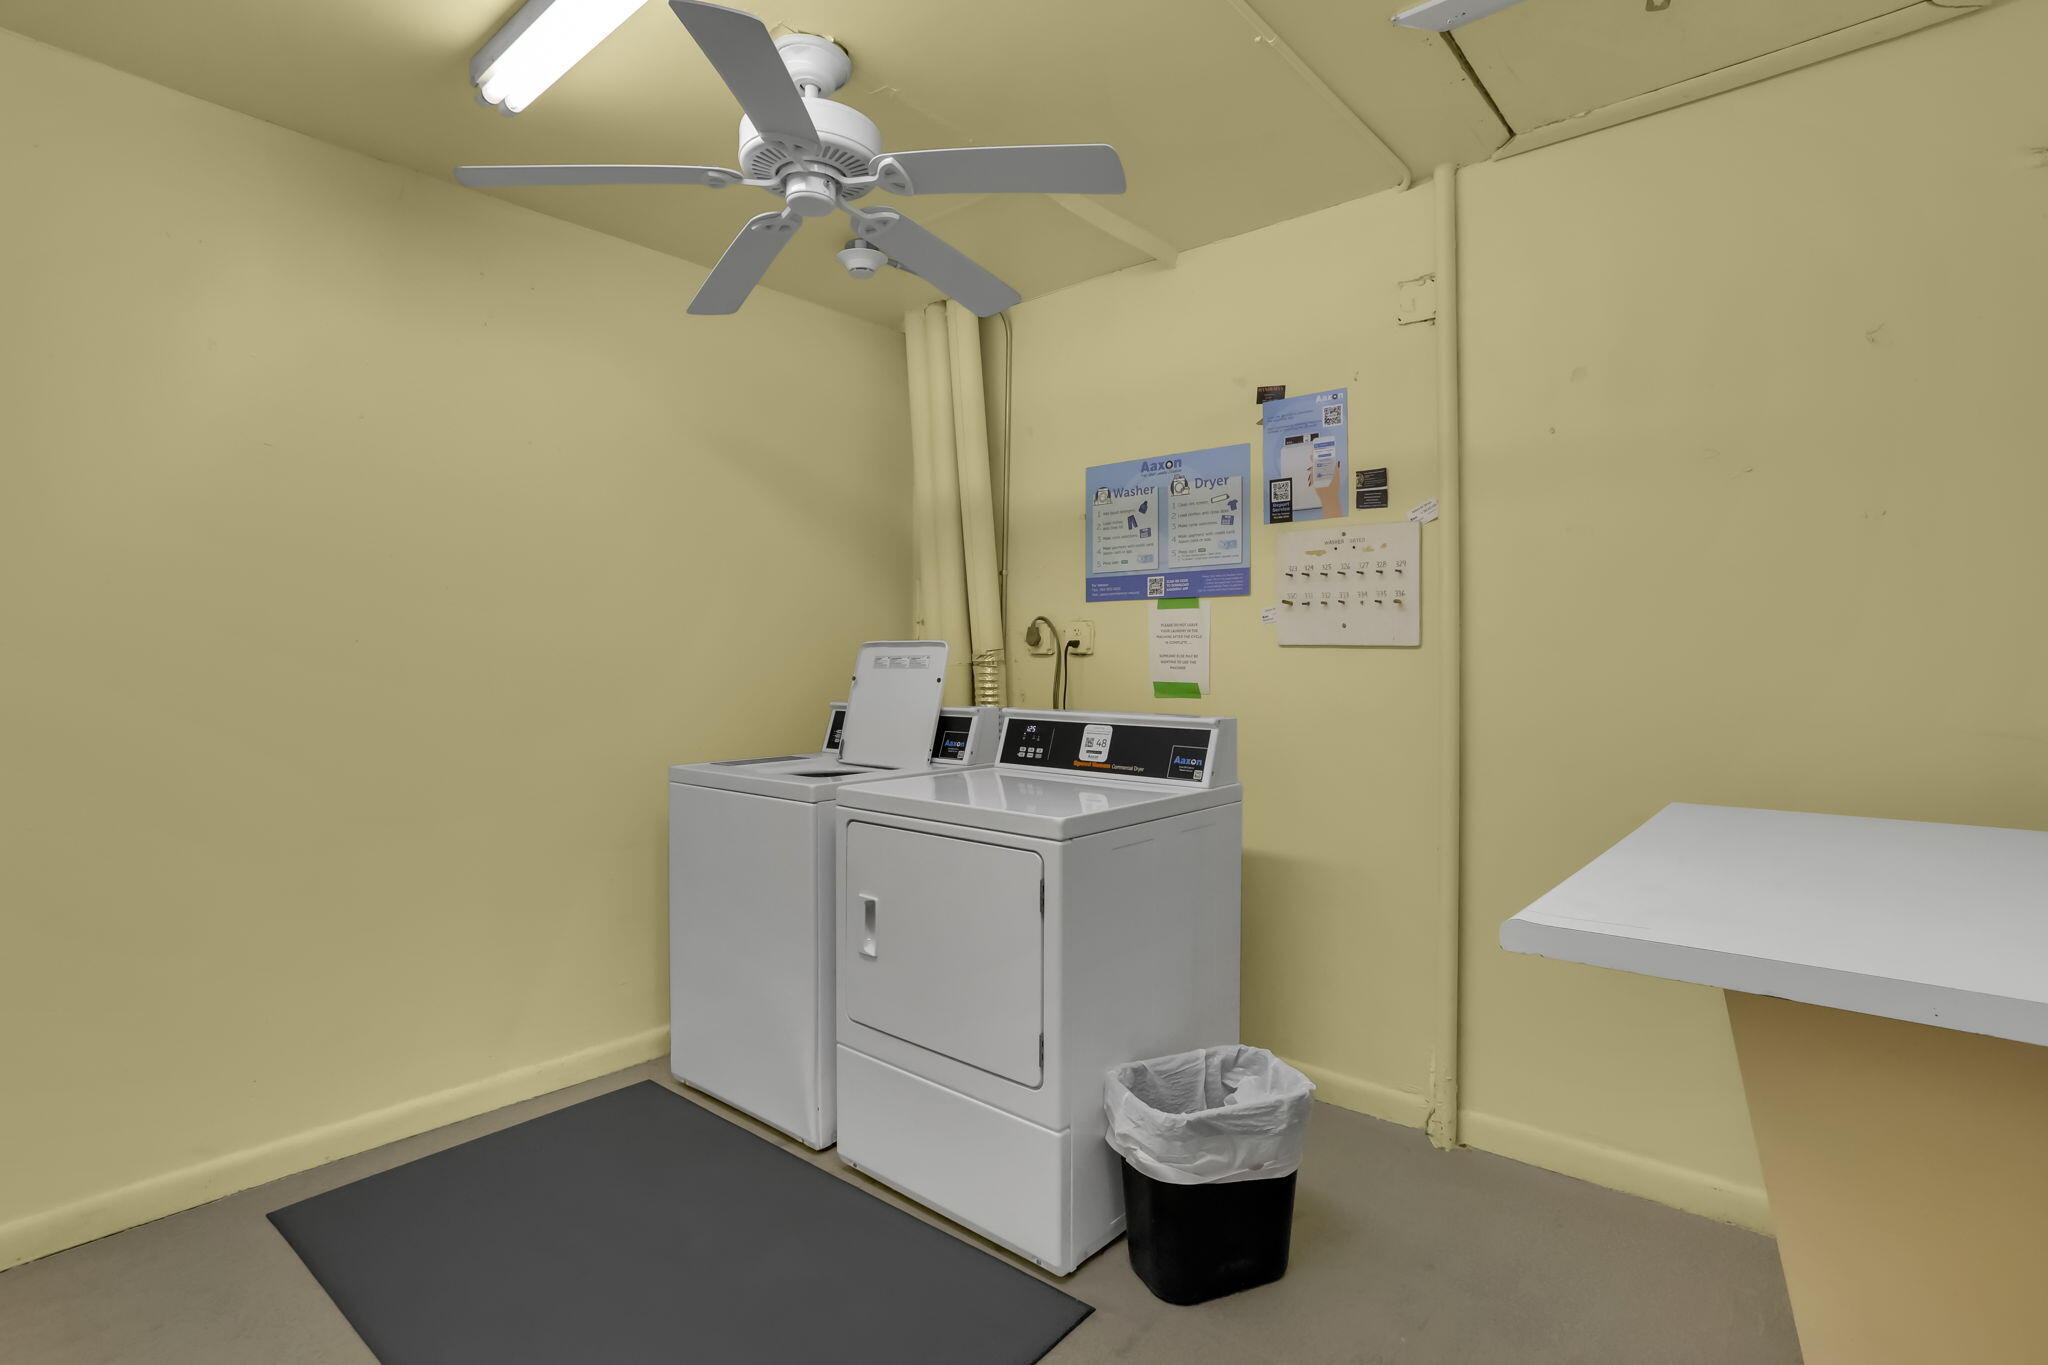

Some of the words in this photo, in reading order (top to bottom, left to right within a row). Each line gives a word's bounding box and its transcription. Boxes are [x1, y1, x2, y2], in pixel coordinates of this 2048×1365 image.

[1315, 392, 1344, 402] Aaxon
[1141, 458, 1182, 473] Aaxon
[1194, 476, 1230, 490] Dryer
[1113, 485, 1155, 499] Washer
[1376, 560, 1387, 568] 328
[1395, 560, 1407, 568] 329
[944, 739, 965, 747] Aaxon
[1096, 738, 1108, 748] 48
[1173, 755, 1203, 766] Aaxon
[1111, 763, 1133, 771] Commercial
[1133, 765, 1145, 773] Dryer
